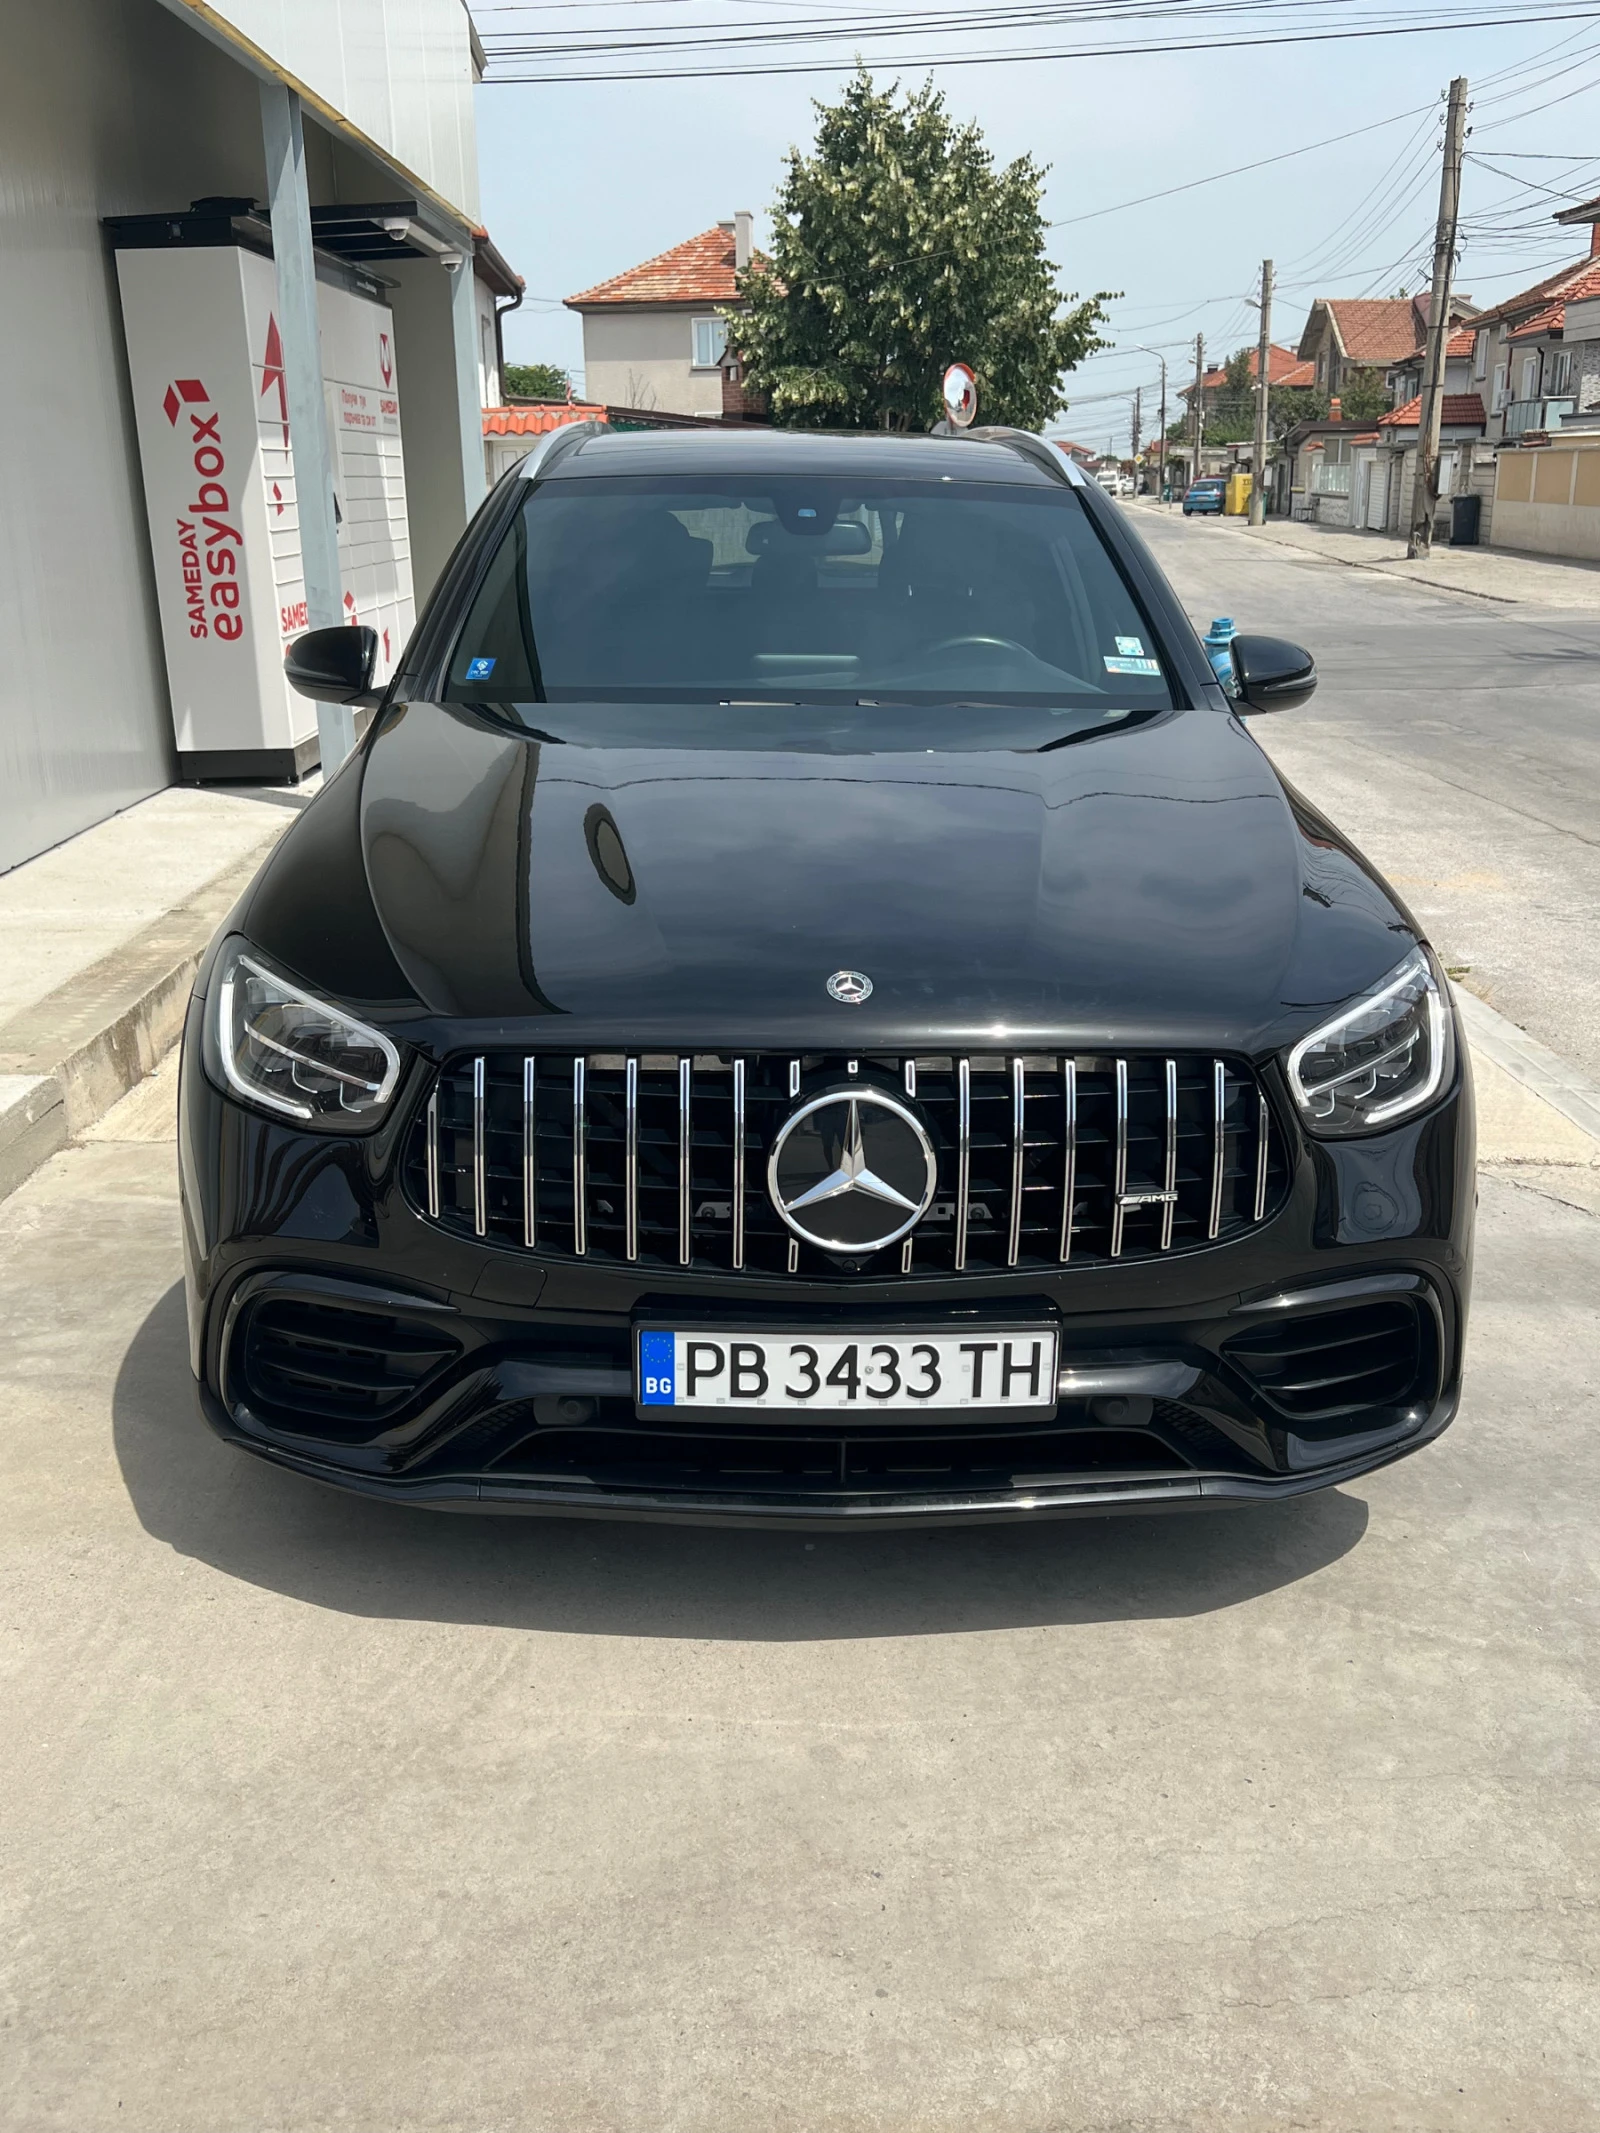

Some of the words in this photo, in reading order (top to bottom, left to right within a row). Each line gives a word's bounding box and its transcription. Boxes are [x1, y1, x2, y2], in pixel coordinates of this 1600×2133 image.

[188, 411, 244, 641] easybox
[177, 518, 208, 640] SAMEDAY
[1138, 1193, 1178, 1203] AMG
[645, 1376, 672, 1395] BG
[685, 1341, 770, 1399] PB
[785, 1343, 942, 1400] 3433
[959, 1341, 1043, 1398] TH
